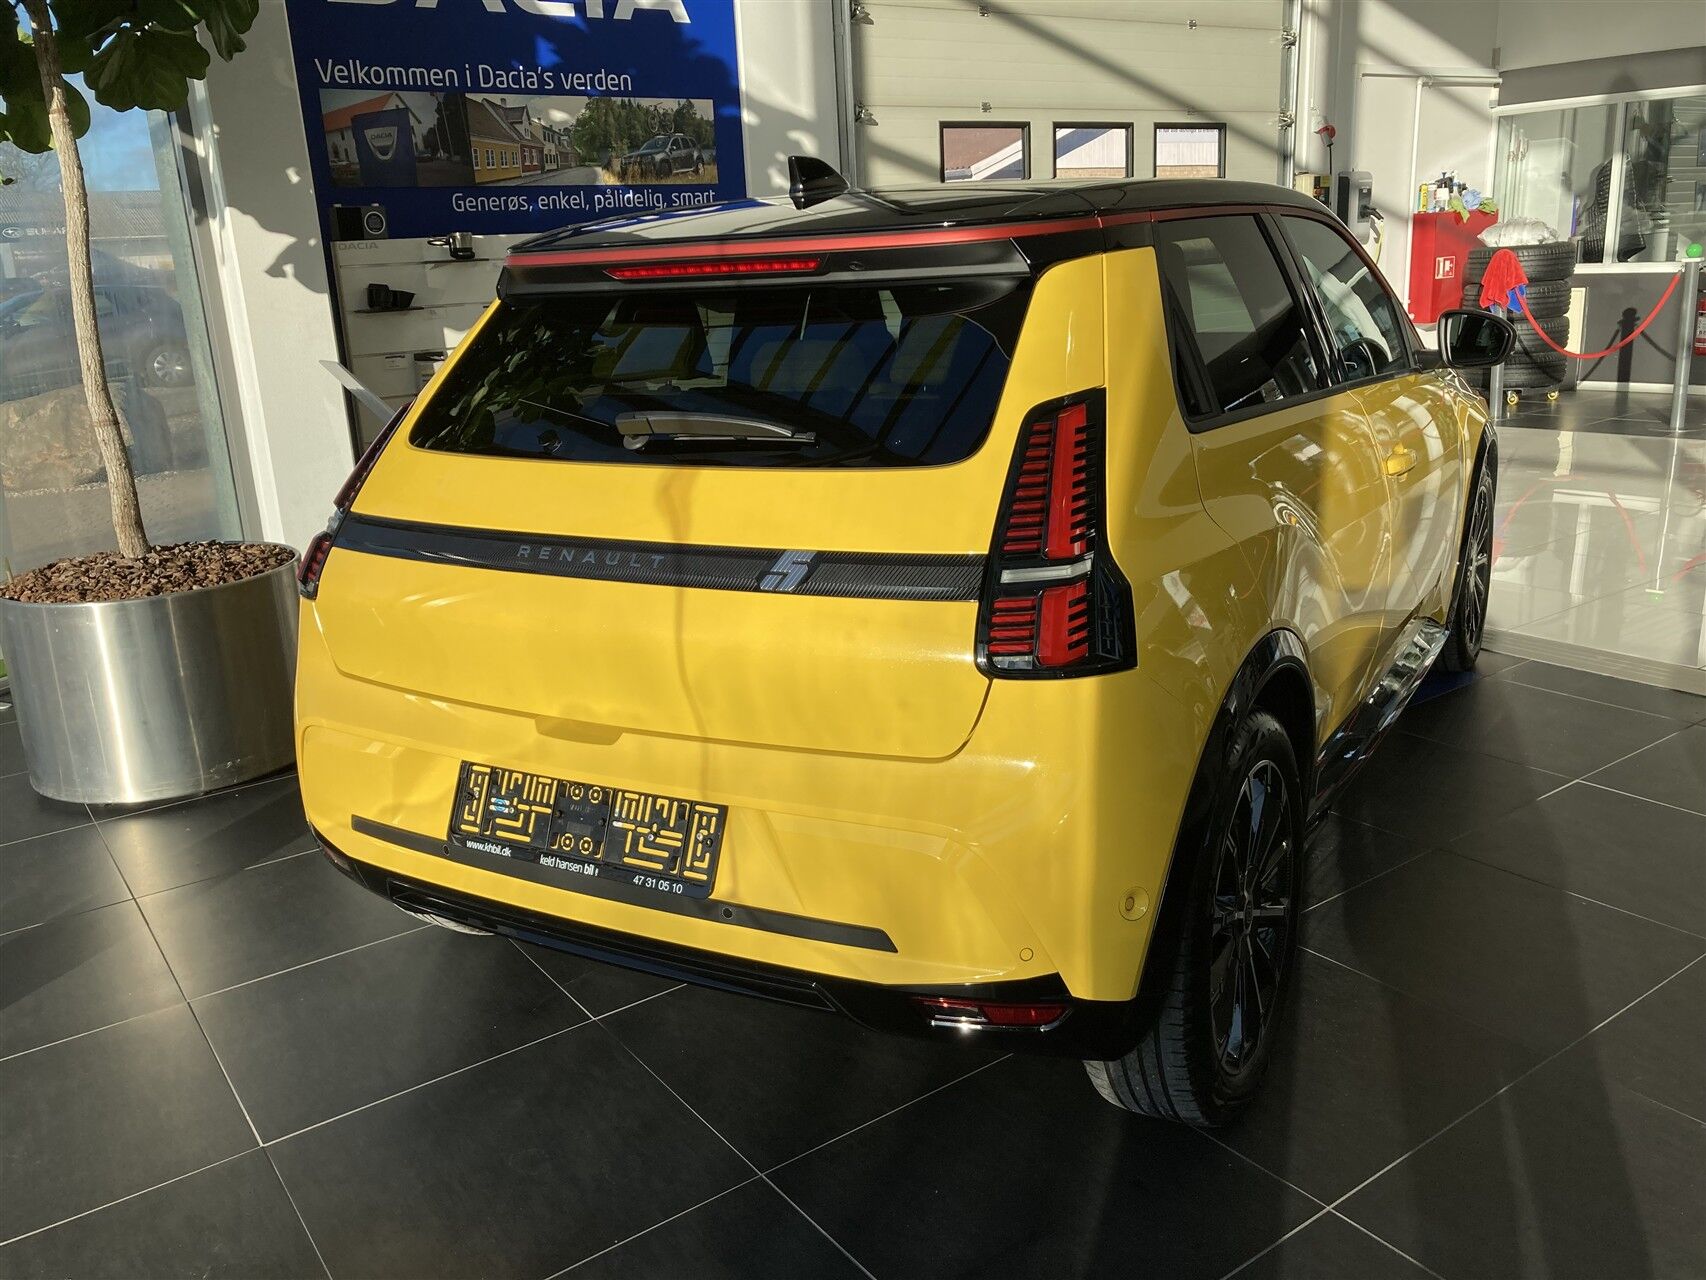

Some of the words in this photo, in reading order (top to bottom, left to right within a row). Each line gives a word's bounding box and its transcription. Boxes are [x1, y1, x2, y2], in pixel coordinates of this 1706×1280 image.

[314, 58, 458, 87] Velkommen
[465, 63, 471, 87] i
[478, 64, 554, 89] Dacia's
[560, 69, 632, 91] verden
[452, 193, 533, 212] Generøs,
[538, 190, 590, 210] enkel,
[595, 189, 668, 213] pålidelig,
[671, 189, 716, 207] smart
[338, 241, 379, 251] DACIA
[517, 545, 664, 569] RENAULT
[466, 840, 511, 857] www.khbil.dk
[540, 854, 556, 868] keld
[556, 857, 582, 873] hansen
[633, 875, 645, 886] 47
[645, 877, 656, 889] 31
[658, 881, 670, 892] 05
[671, 883, 683, 895] 10
